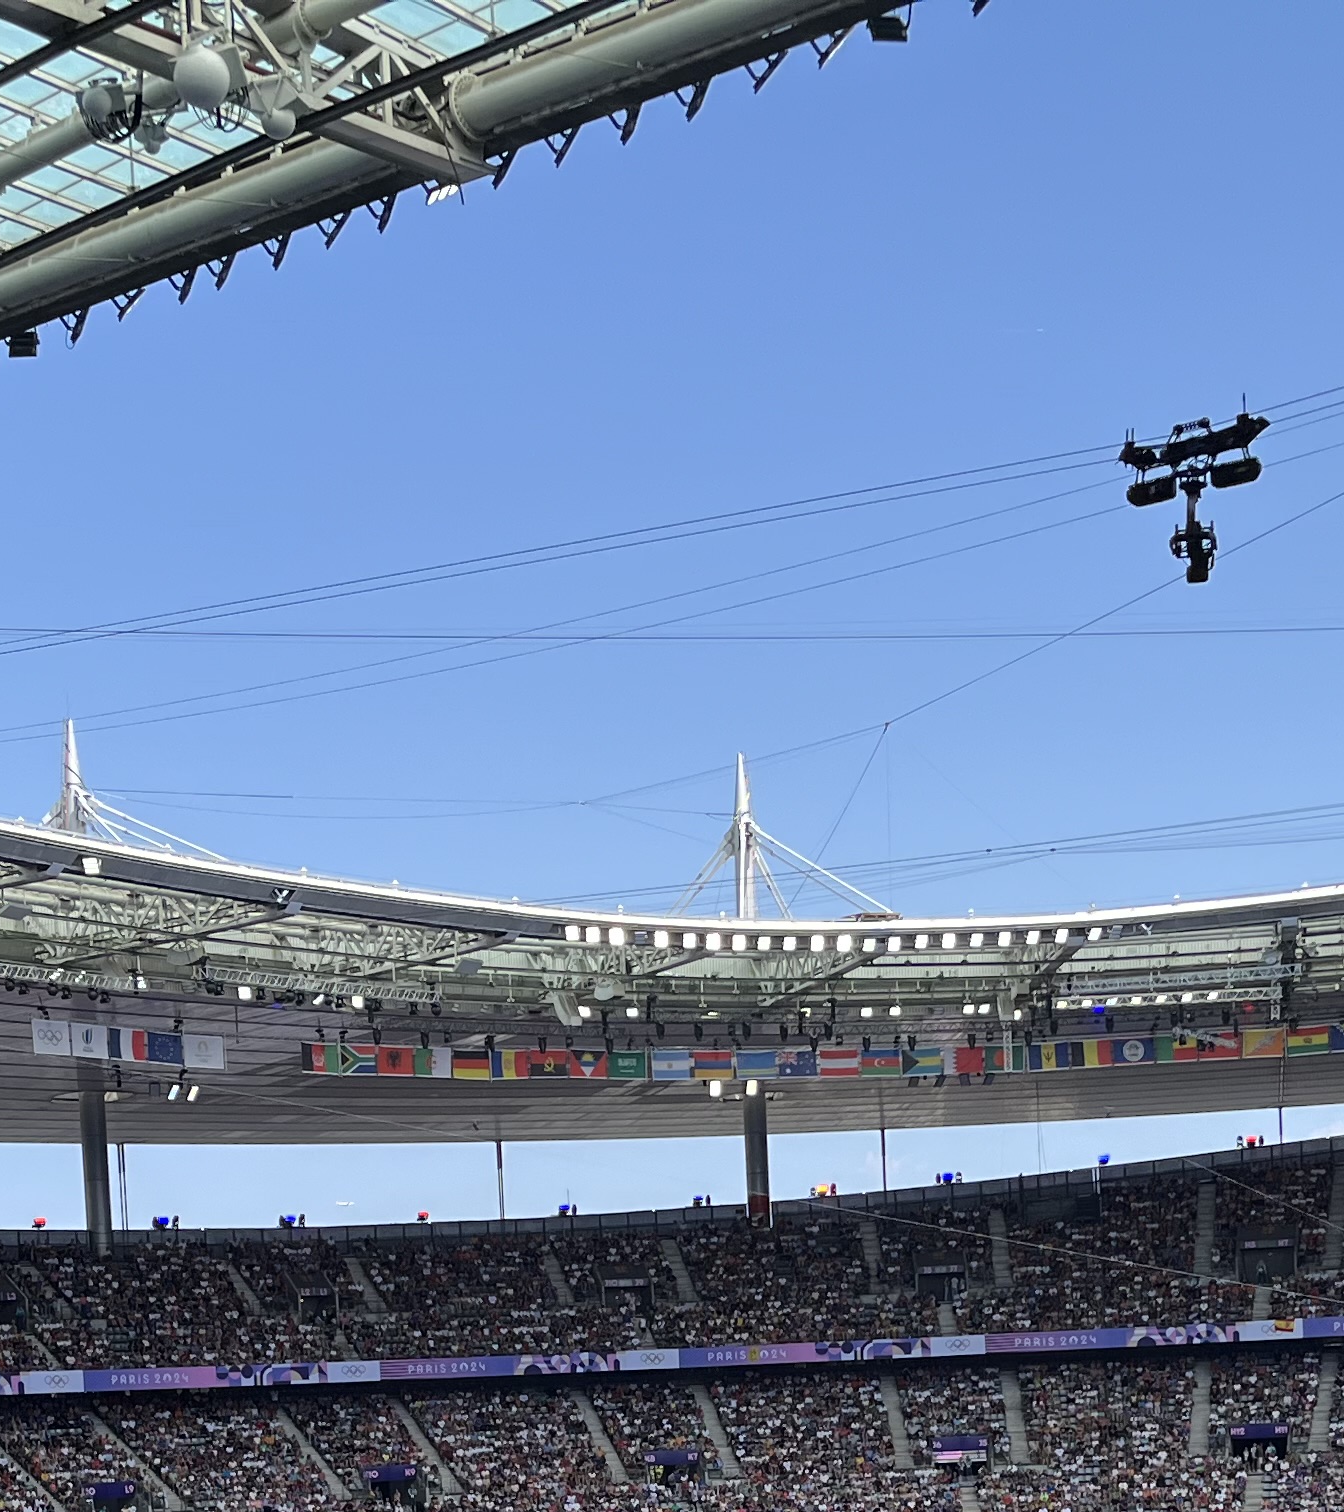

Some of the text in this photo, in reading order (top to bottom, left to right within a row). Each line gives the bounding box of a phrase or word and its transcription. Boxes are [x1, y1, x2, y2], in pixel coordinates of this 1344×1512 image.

[1060, 1335, 1096, 1346] 2024
[750, 1349, 787, 1361] 2024
[451, 1361, 485, 1373] 2024
[155, 1372, 189, 1384] 2024
